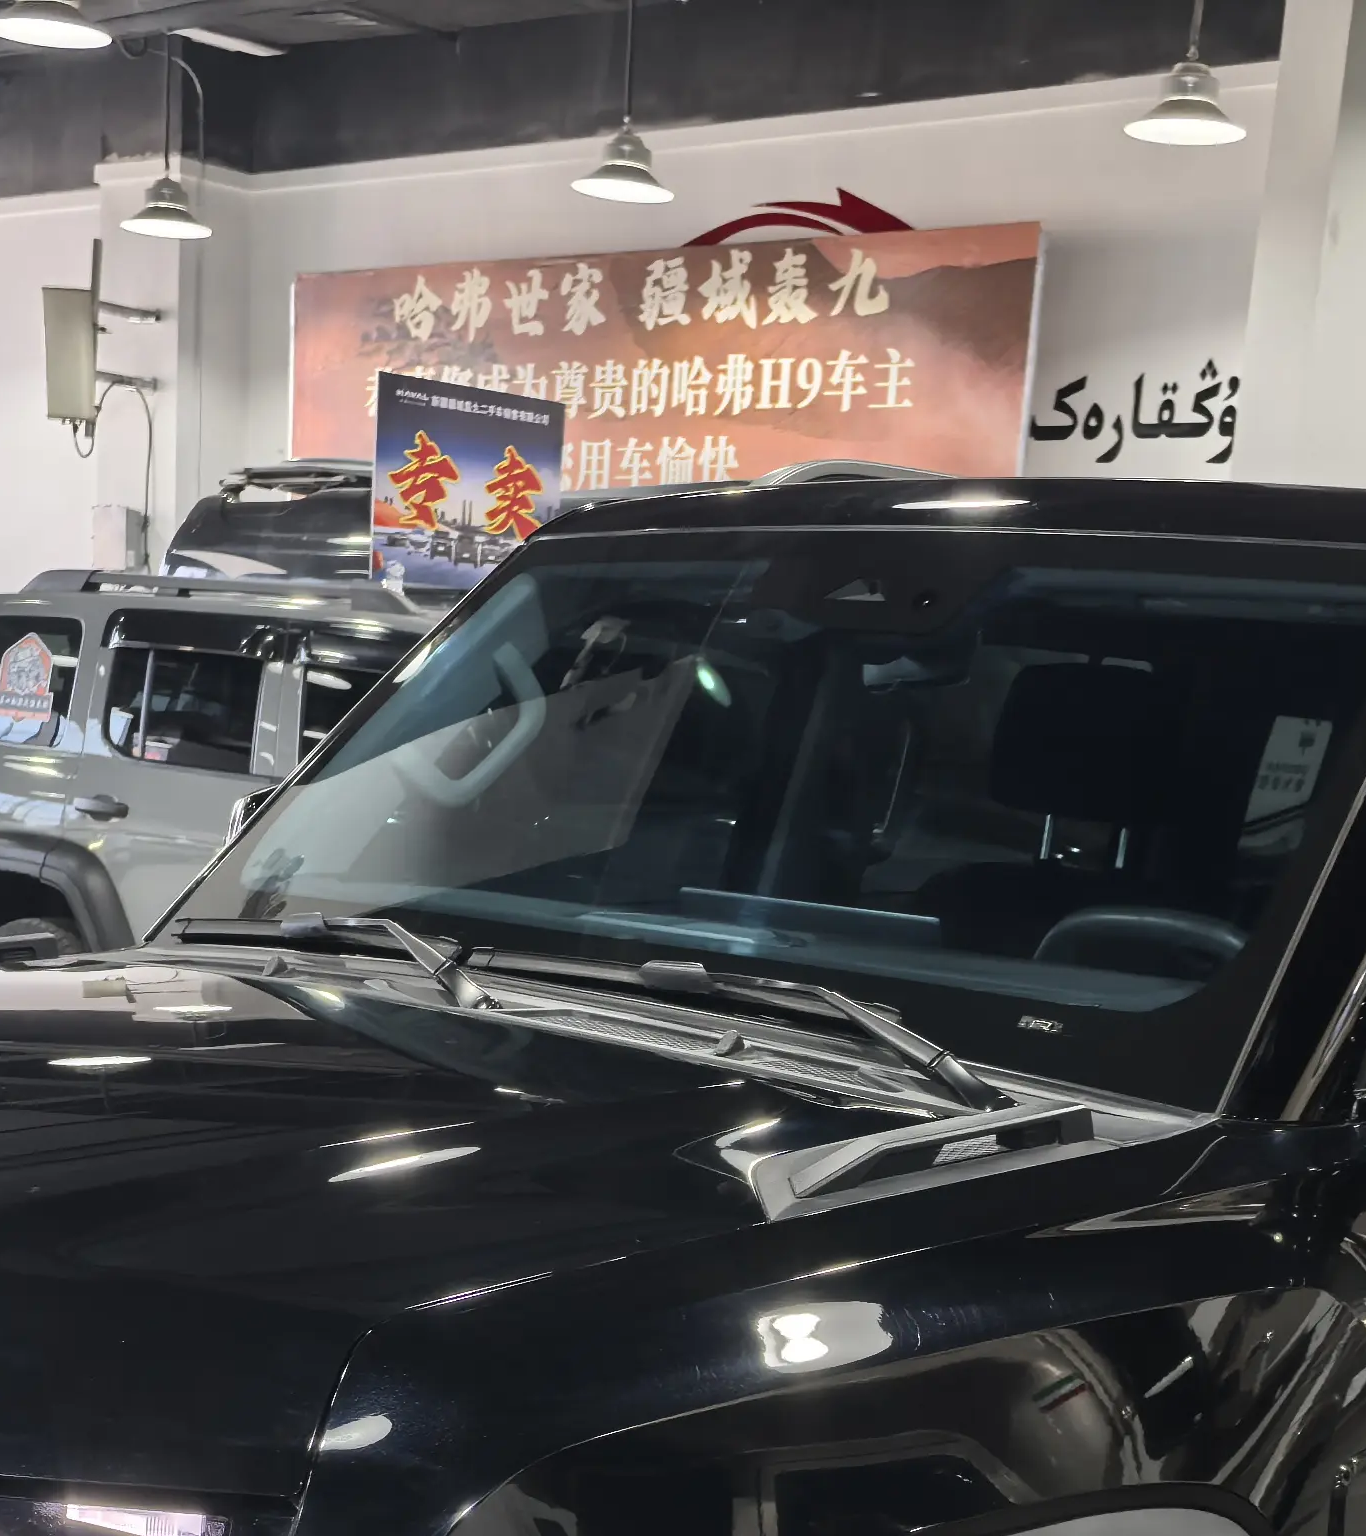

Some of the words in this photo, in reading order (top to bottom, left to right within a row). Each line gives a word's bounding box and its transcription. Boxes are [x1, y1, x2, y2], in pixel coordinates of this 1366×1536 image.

[393, 262, 607, 343] 哈弗世家
[638, 248, 891, 331] 疆域轰九
[560, 435, 739, 491] 用车愉快
